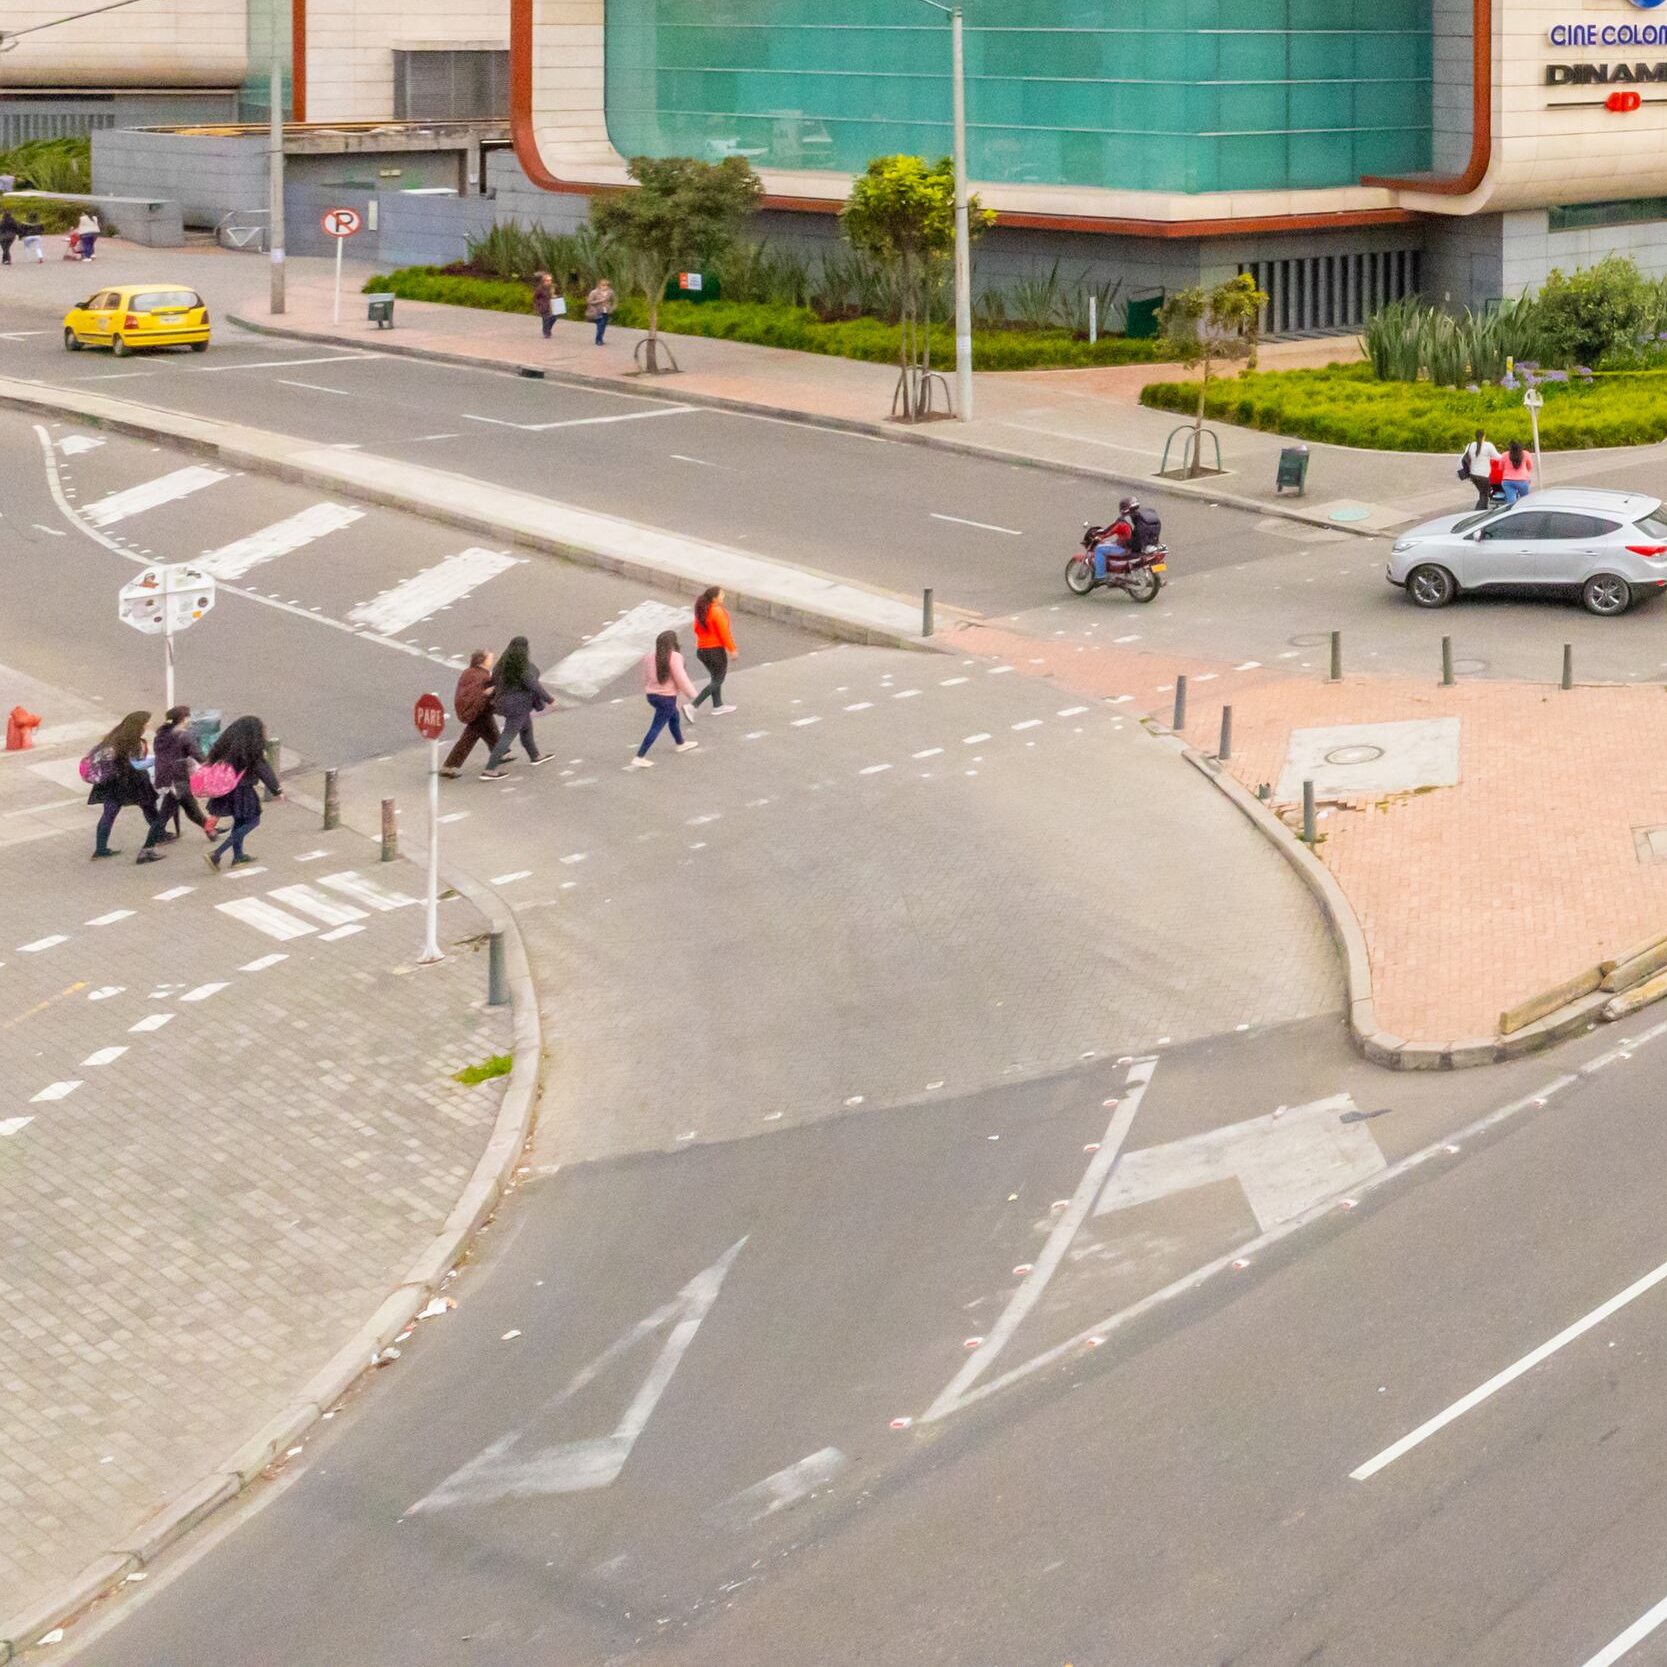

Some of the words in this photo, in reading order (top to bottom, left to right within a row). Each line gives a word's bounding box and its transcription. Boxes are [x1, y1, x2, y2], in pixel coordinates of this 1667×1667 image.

[1550, 24, 1597, 46] CINE
[1605, 91, 1642, 113] 4D
[417, 707, 442, 727] PARE
